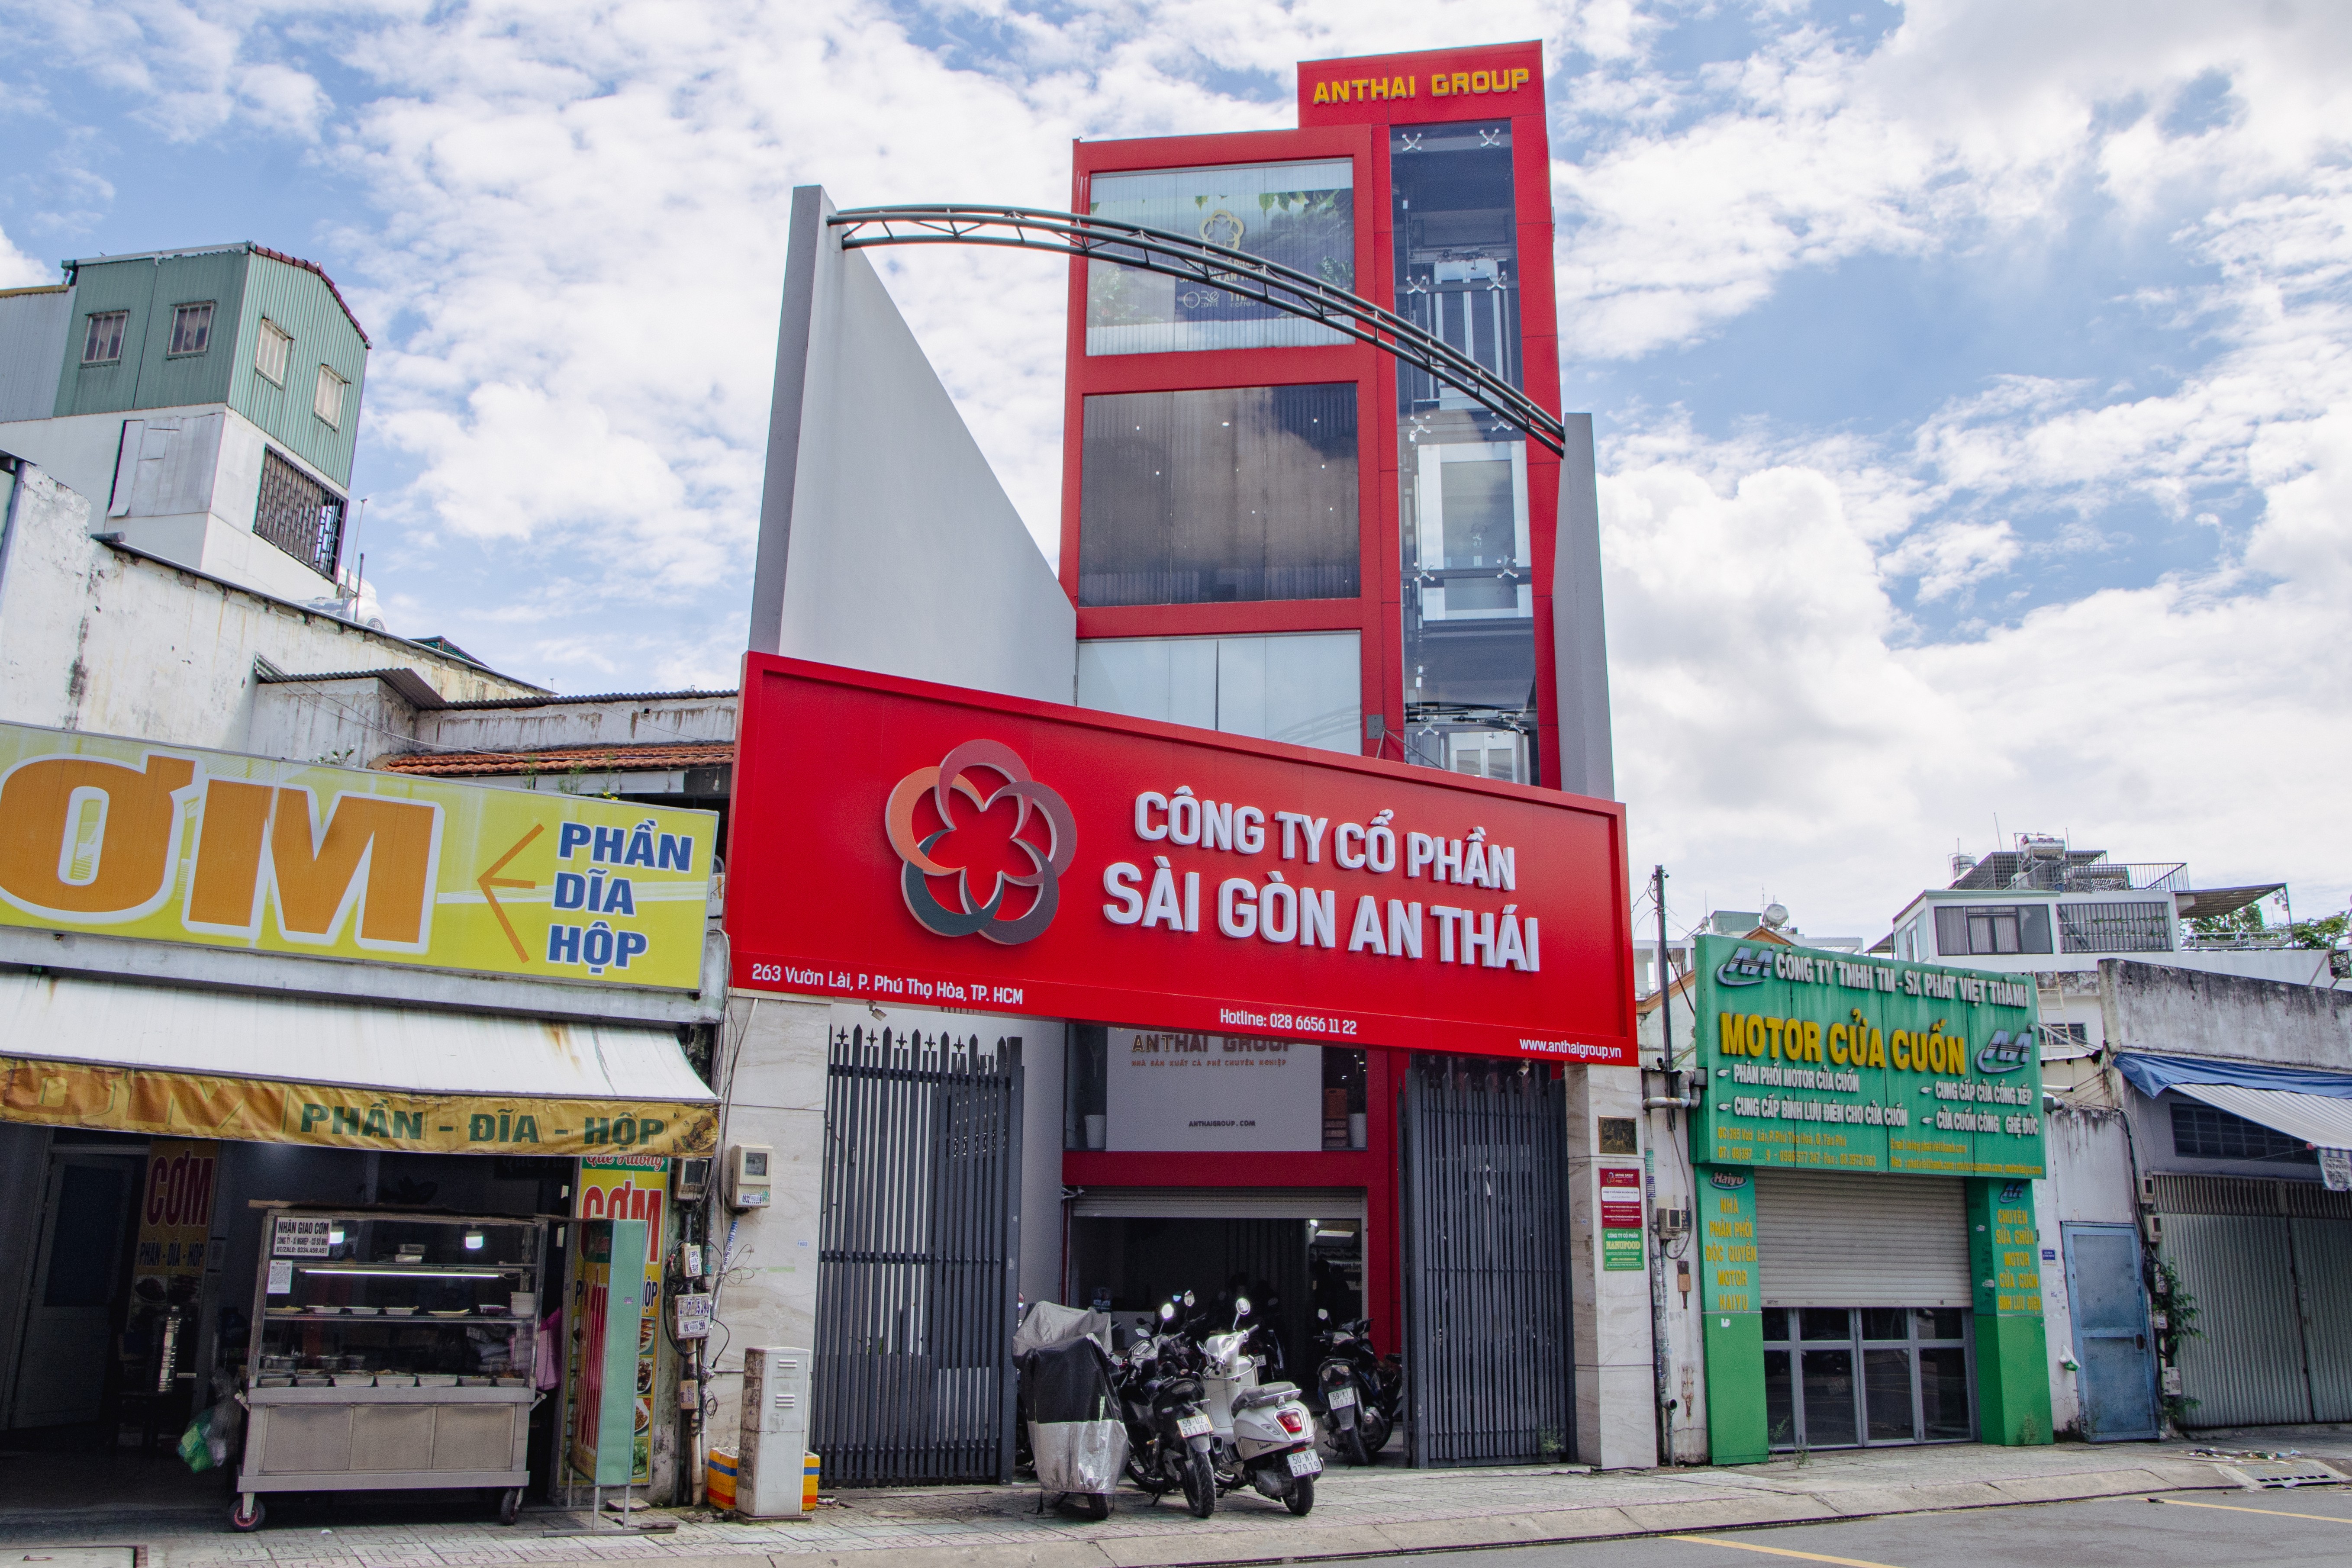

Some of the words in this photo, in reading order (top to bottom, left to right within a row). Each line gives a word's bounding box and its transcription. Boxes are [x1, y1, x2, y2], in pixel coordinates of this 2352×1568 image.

[1313, 76, 1414, 104] ANTHAI
[1431, 68, 1529, 97] GROUP
[559, 819, 693, 873] PHẦN
[1135, 786, 1264, 855] CÔNG
[1275, 811, 1328, 864] TY
[1335, 809, 1395, 873] CỔ
[1406, 826, 1515, 891] PHẦN
[554, 868, 636, 917] DĨA
[1103, 856, 1199, 933] SÀI
[1218, 871, 1335, 948] GÒN
[1347, 895, 1422, 959] AN
[1431, 904, 1540, 972] THÁI
[546, 921, 648, 974] HỘP
[752, 963, 781, 981] 263
[785, 966, 823, 986] Vườn
[829, 971, 853, 991] Lài,
[858, 974, 870, 991] P.
[874, 975, 902, 993] Phú
[906, 978, 932, 999] Thọ
[937, 981, 967, 1001] Hòa,
[971, 984, 989, 1001] TP.
[993, 987, 1023, 1005] HCM
[1775, 948, 1814, 982] CÔNG
[1816, 959, 1834, 984] TY
[1836, 961, 1874, 989] TNHH
[1875, 967, 1896, 992] TM
[1905, 970, 1922, 995] SX
[1923, 969, 1956, 998] PHÁT
[1958, 972, 1986, 1007] VIỆT
[1989, 977, 2029, 1007] THÀNH
[1220, 1009, 1267, 1027] Hotline:
[1269, 1013, 1292, 1029] 028
[1295, 1015, 1325, 1032] 6656
[1328, 1018, 1339, 1034] 11
[1342, 1020, 1357, 1035] 22
[1132, 1034, 1208, 1052] ANTHAI
[1519, 1039, 1621, 1060] www.anthaigroup.vn
[1720, 1012, 1822, 1062] MOTOR
[1828, 1008, 1886, 1068] CỬA
[1891, 1019, 1965, 1075] CUỐN
[1733, 1060, 1759, 1084] PHÂN
[1760, 1062, 1782, 1086] PHỐI
[1784, 1069, 1815, 1088] MOTOR
[1817, 1065, 1834, 1091] CỬA
[1835, 1069, 1859, 1092] CUỐN
[1935, 1081, 1958, 1100] CUNG
[1959, 1079, 1975, 1101] CẤP
[1977, 1079, 1993, 1102] CỬA
[2017, 1083, 2033, 1105] XẾP
[1734, 1096, 1759, 1117] CUNG
[1761, 1093, 1779, 1118] CẤP
[1781, 1095, 1804, 1120] BÌNH
[1846, 1104, 1864, 1124] CHO
[1865, 1100, 1883, 1125] CỬA
[1884, 1102, 1908, 1127] CUỐN
[1953, 1108, 1976, 1131] CUỐN
[301, 1098, 425, 1140] PHẦN
[468, 1104, 541, 1143] ĐĨA
[583, 1111, 667, 1151] HỘP
[147, 1150, 214, 1227] CƠM
[1714, 1172, 1743, 1186] Haiyu
[1720, 1193, 1738, 1214] NHÀ
[1997, 1207, 2027, 1224] CHUYÊN
[278, 1219, 296, 1236] NHẬN
[298, 1222, 313, 1234] GIAO
[315, 1222, 329, 1235] CƠM
[1709, 1218, 1731, 1237] PHÂN
[1734, 1215, 1752, 1238] PHỐI
[1706, 1242, 1723, 1266] ĐỘC
[2004, 1252, 2030, 1266] MOTOR
[1717, 1270, 1747, 1286] MOTOR
[642, 1275, 657, 1313] ỘP
[1719, 1294, 1748, 1310] HAIYU
[1332, 1390, 1348, 1400] 59-K1
[1182, 1417, 1204, 1427] 59-U2
[1182, 1423, 1210, 1436] 311.00
[1292, 1452, 1313, 1465] 50-N1
[1293, 1461, 1319, 1475] 379.19
